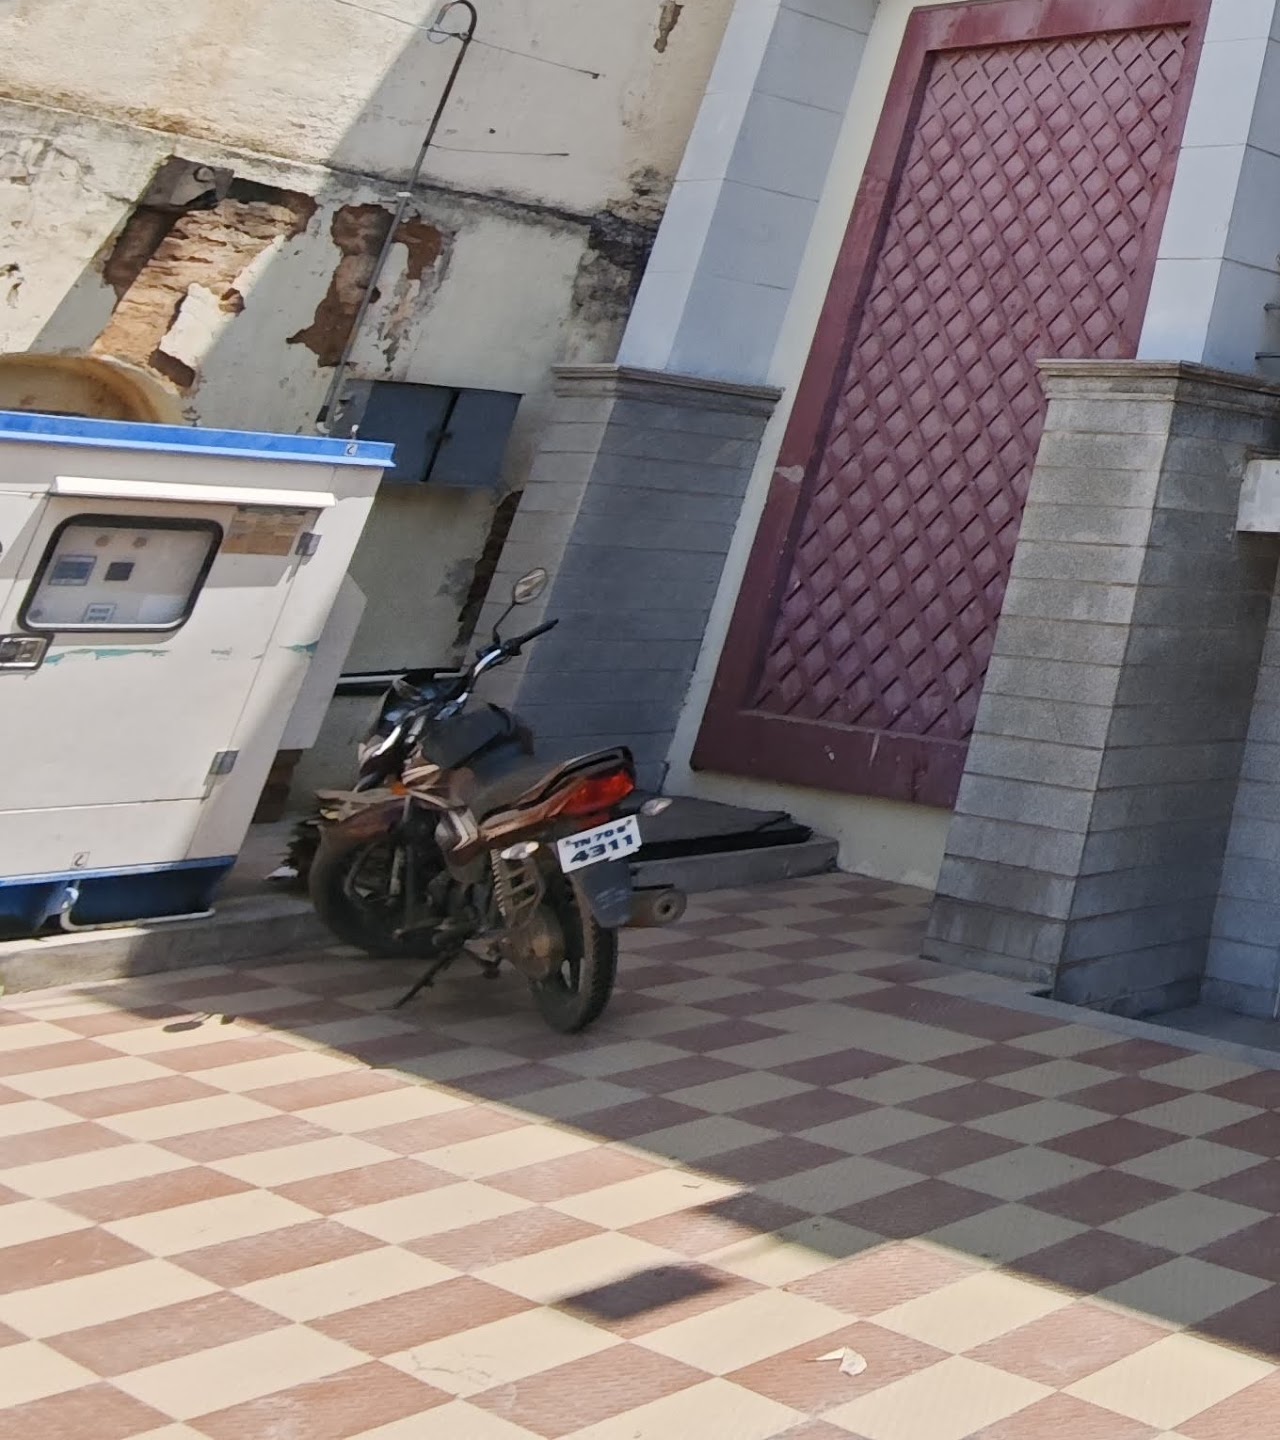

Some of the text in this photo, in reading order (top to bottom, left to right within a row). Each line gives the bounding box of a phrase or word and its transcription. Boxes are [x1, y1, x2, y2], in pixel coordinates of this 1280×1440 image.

[570, 834, 634, 863] 4311
[572, 837, 591, 849] TN
[594, 829, 614, 841] 70
